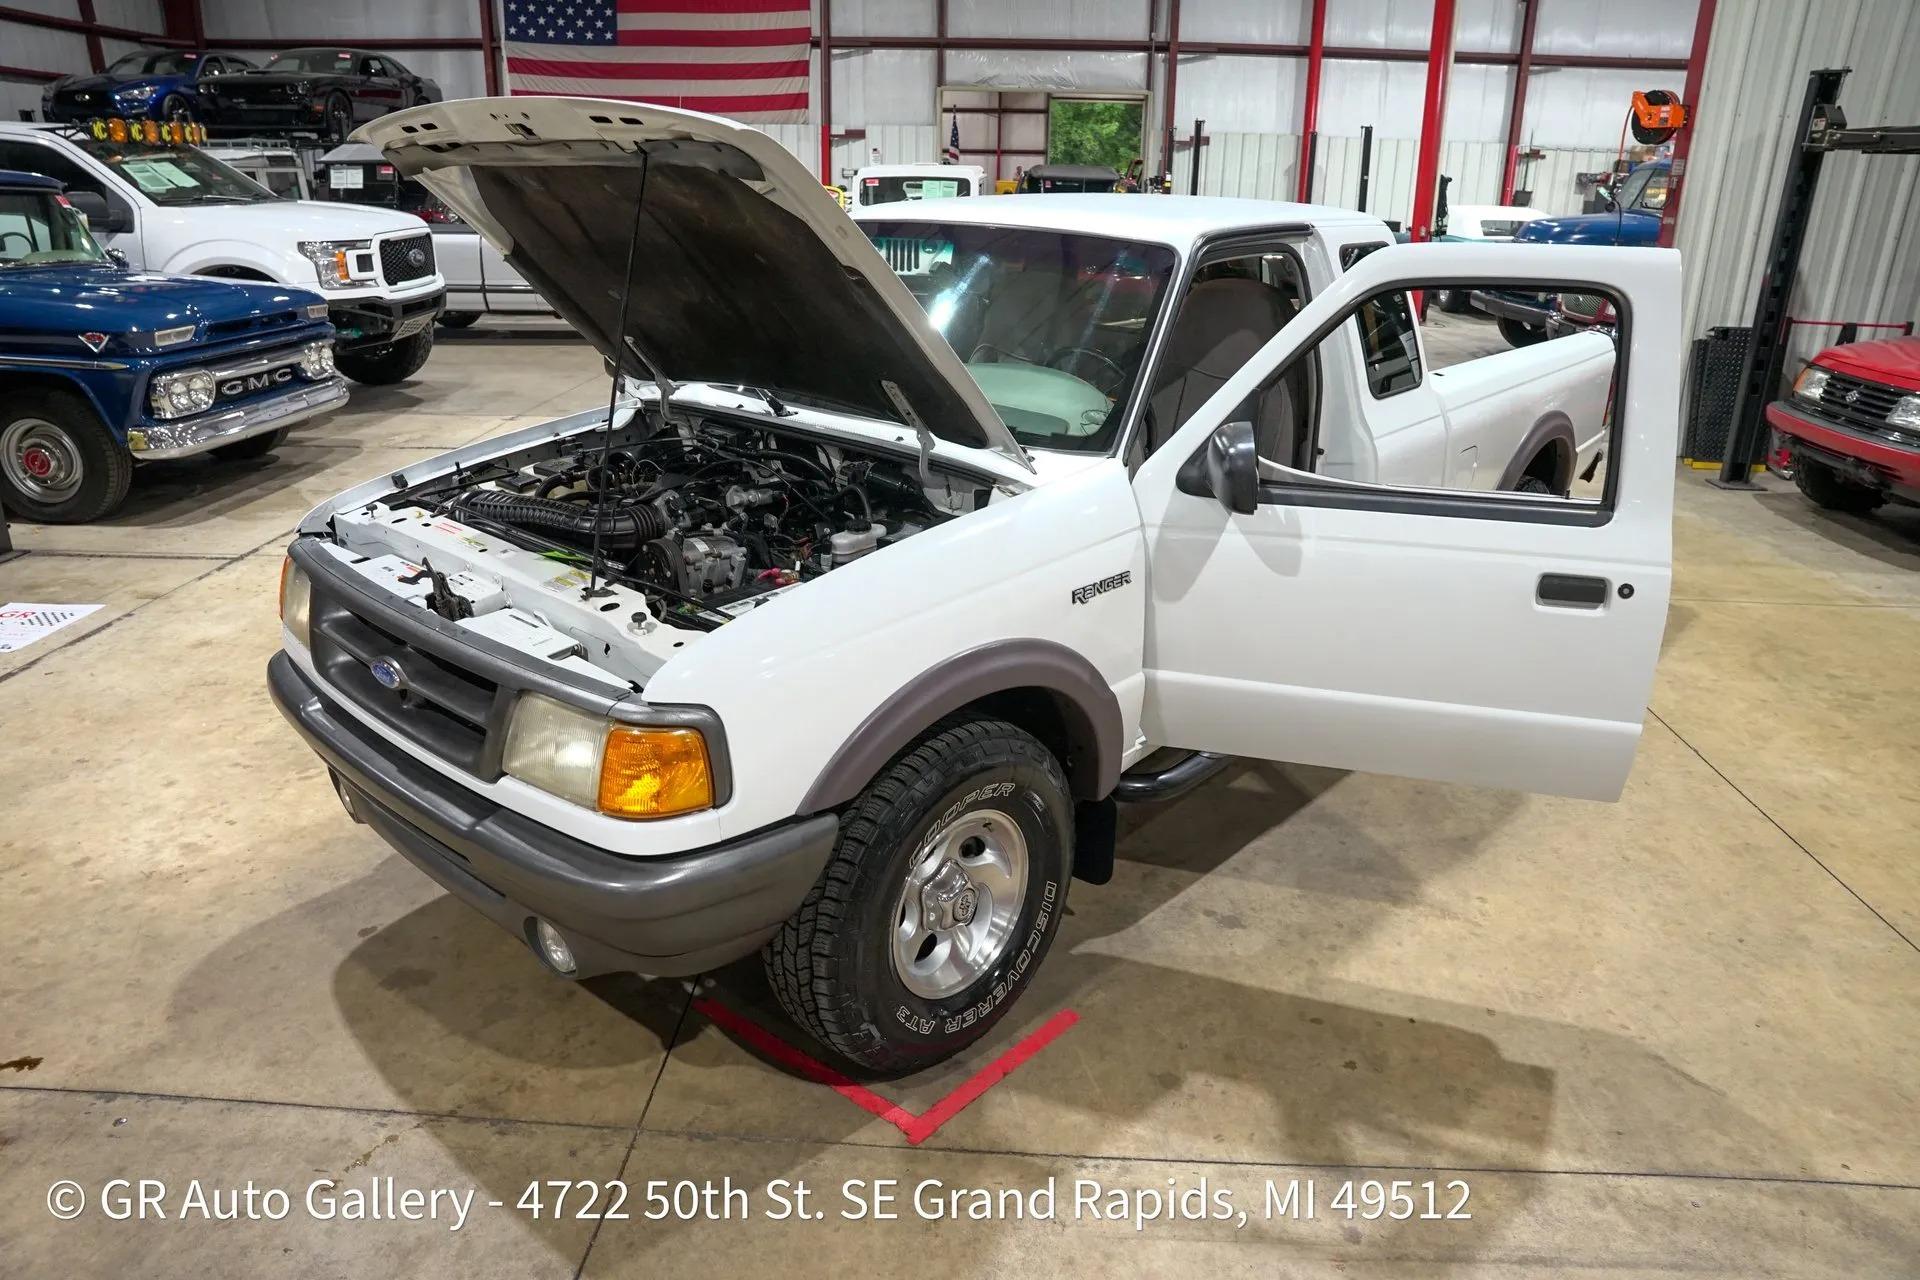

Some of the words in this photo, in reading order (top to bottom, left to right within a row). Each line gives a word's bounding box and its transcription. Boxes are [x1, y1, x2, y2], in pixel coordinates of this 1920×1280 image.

[221, 367, 293, 395] GMC
[1072, 570, 1132, 605] RANGER
[908, 782, 1016, 870] COOPER
[944, 880, 1058, 1034] DISCOVERER
[895, 1005, 936, 1035] AT3
